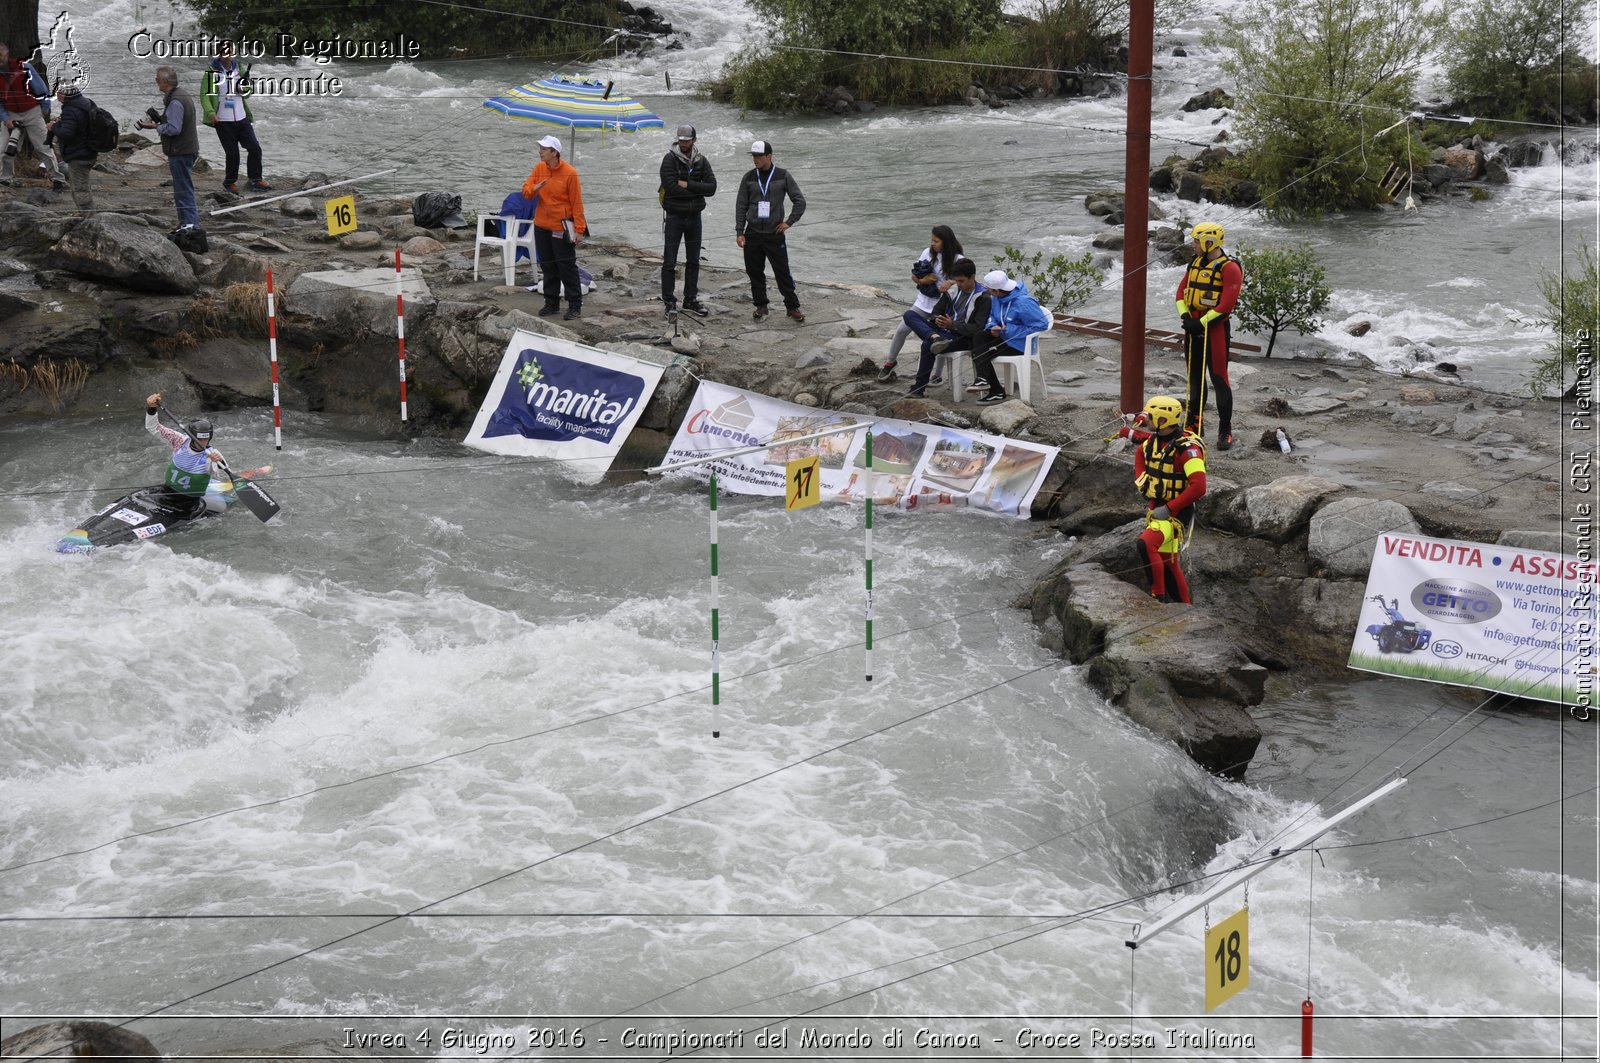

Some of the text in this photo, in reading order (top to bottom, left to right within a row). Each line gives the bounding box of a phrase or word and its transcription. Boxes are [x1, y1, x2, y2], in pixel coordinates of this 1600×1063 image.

[333, 204, 351, 227] 16
[526, 381, 633, 424] manital
[535, 411, 564, 430] facility
[687, 409, 759, 446] Clemente
[170, 469, 192, 490] 14
[749, 466, 787, 480] Borgofranc
[794, 466, 813, 499] 17
[1384, 536, 1600, 584] VENDITA ASSIST
[1424, 582, 1457, 592] MACCHINE
[1422, 592, 1489, 612] GETTO
[1513, 597, 1528, 610] Via
[1427, 609, 1475, 620] GIARDINAGGIO
[1531, 618, 1547, 631] Tel.
[1434, 643, 1460, 655] BCS
[1466, 652, 1508, 666] HITACHI
[1524, 661, 1570, 675] Husqvarna
[1214, 929, 1241, 988] 18
